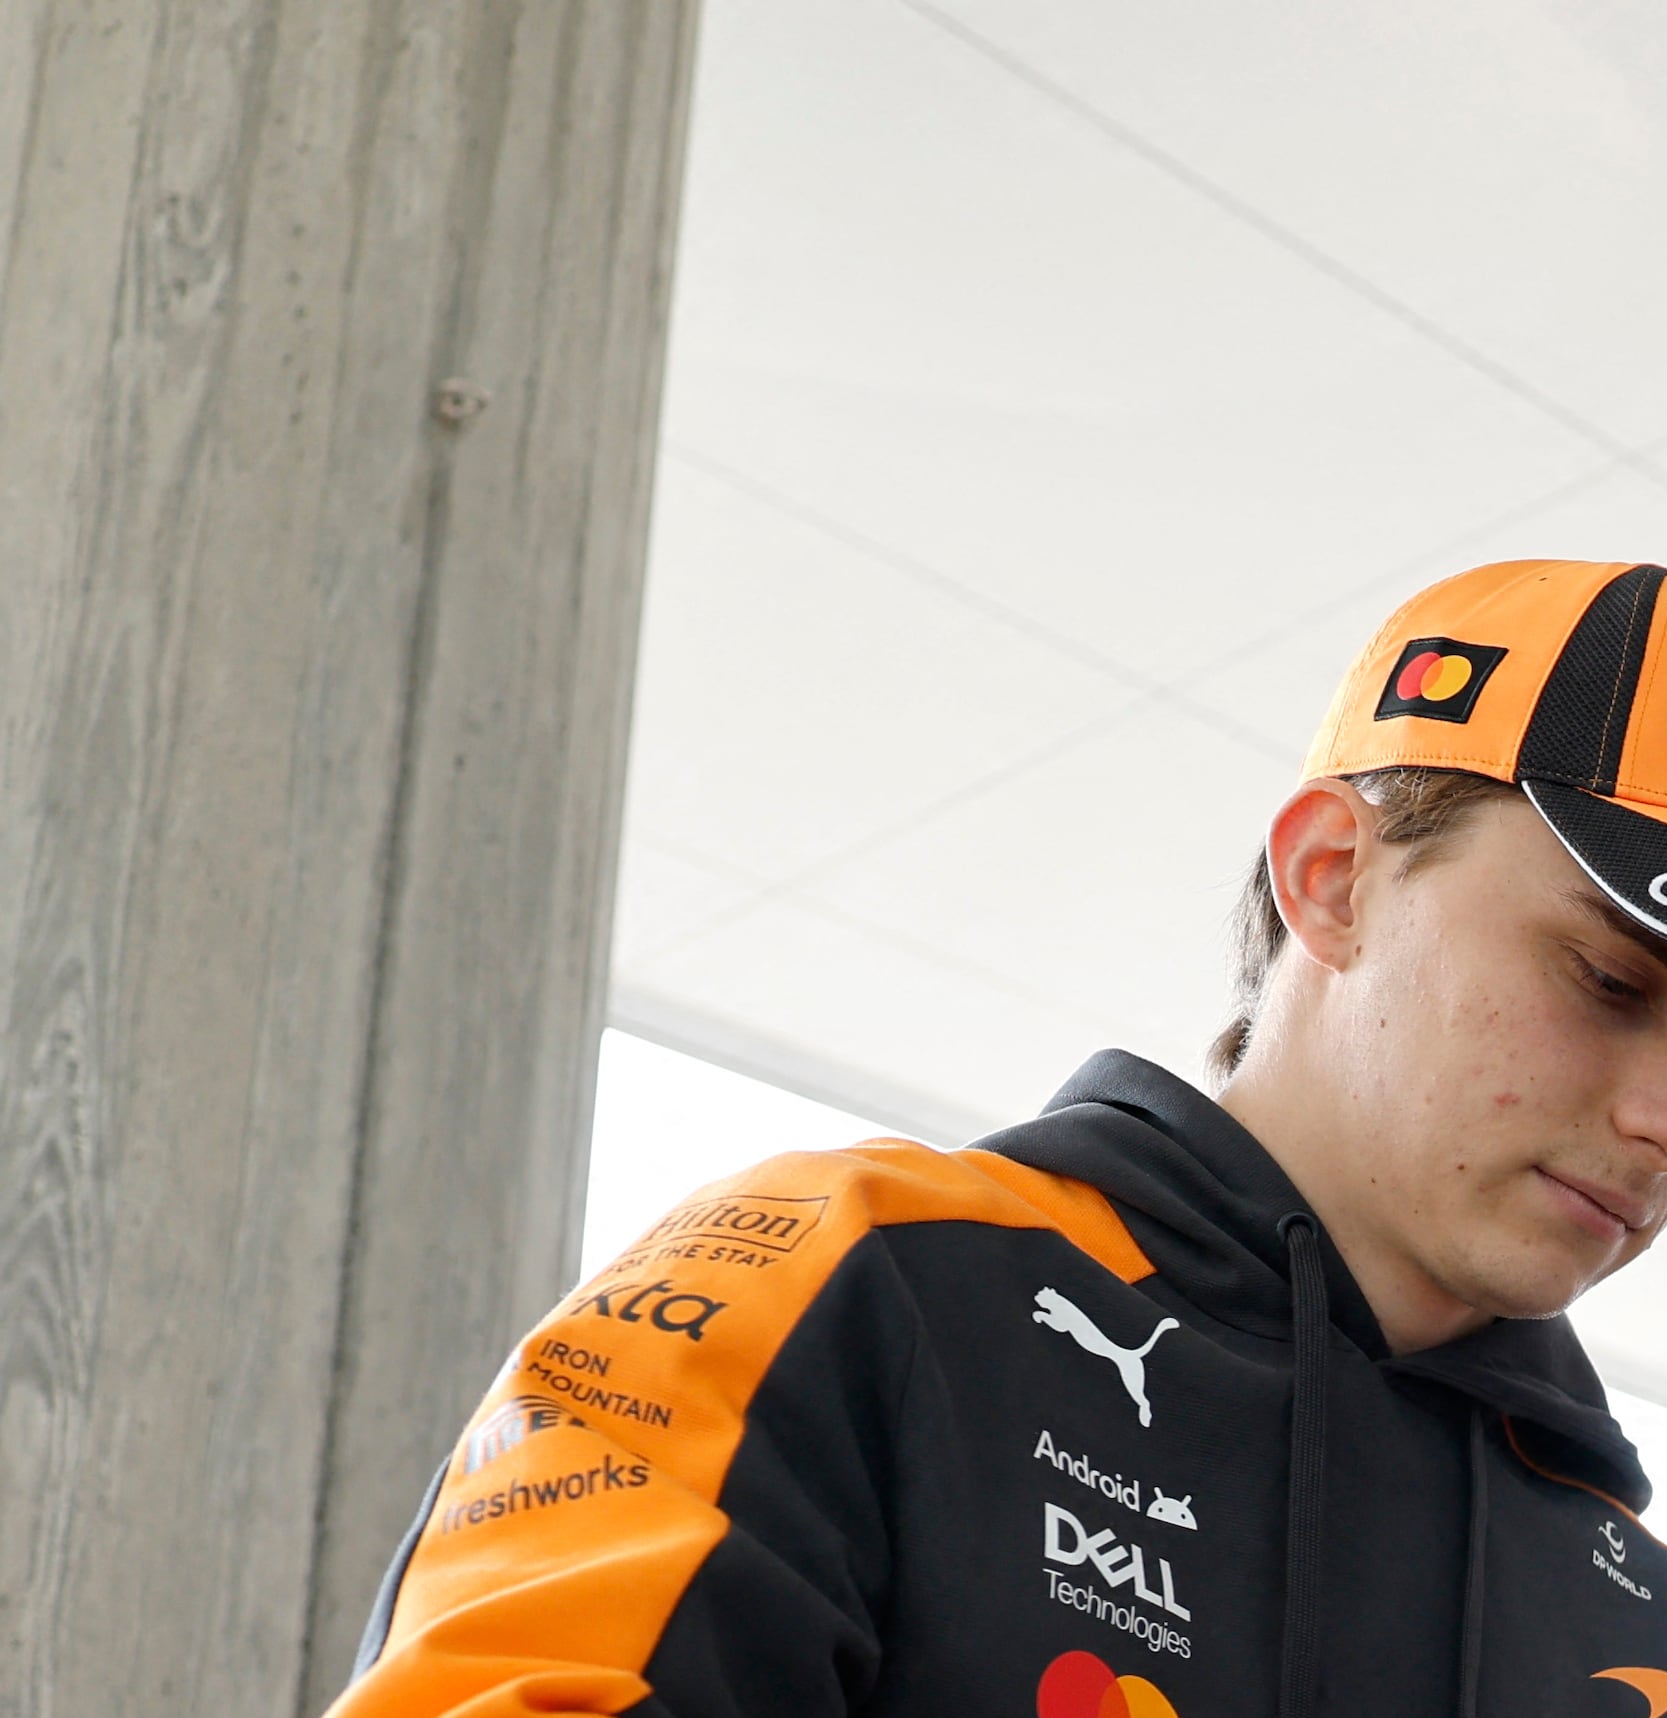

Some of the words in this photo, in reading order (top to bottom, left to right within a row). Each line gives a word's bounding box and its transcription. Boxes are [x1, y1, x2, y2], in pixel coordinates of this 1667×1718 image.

[642, 1203, 800, 1242] Hilton
[654, 1244, 703, 1262] THE
[708, 1246, 780, 1268] STAY
[569, 1280, 729, 1342] kta
[540, 1339, 612, 1377] IRON
[527, 1362, 673, 1429] MOUNTAIN
[442, 1454, 650, 1534] freshworks
[1033, 1429, 1140, 1512] Android
[1044, 1502, 1191, 1622] DELL
[1592, 1549, 1607, 1570] DP
[1605, 1562, 1652, 1600] WORLD
[1042, 1568, 1191, 1659] Technologies
